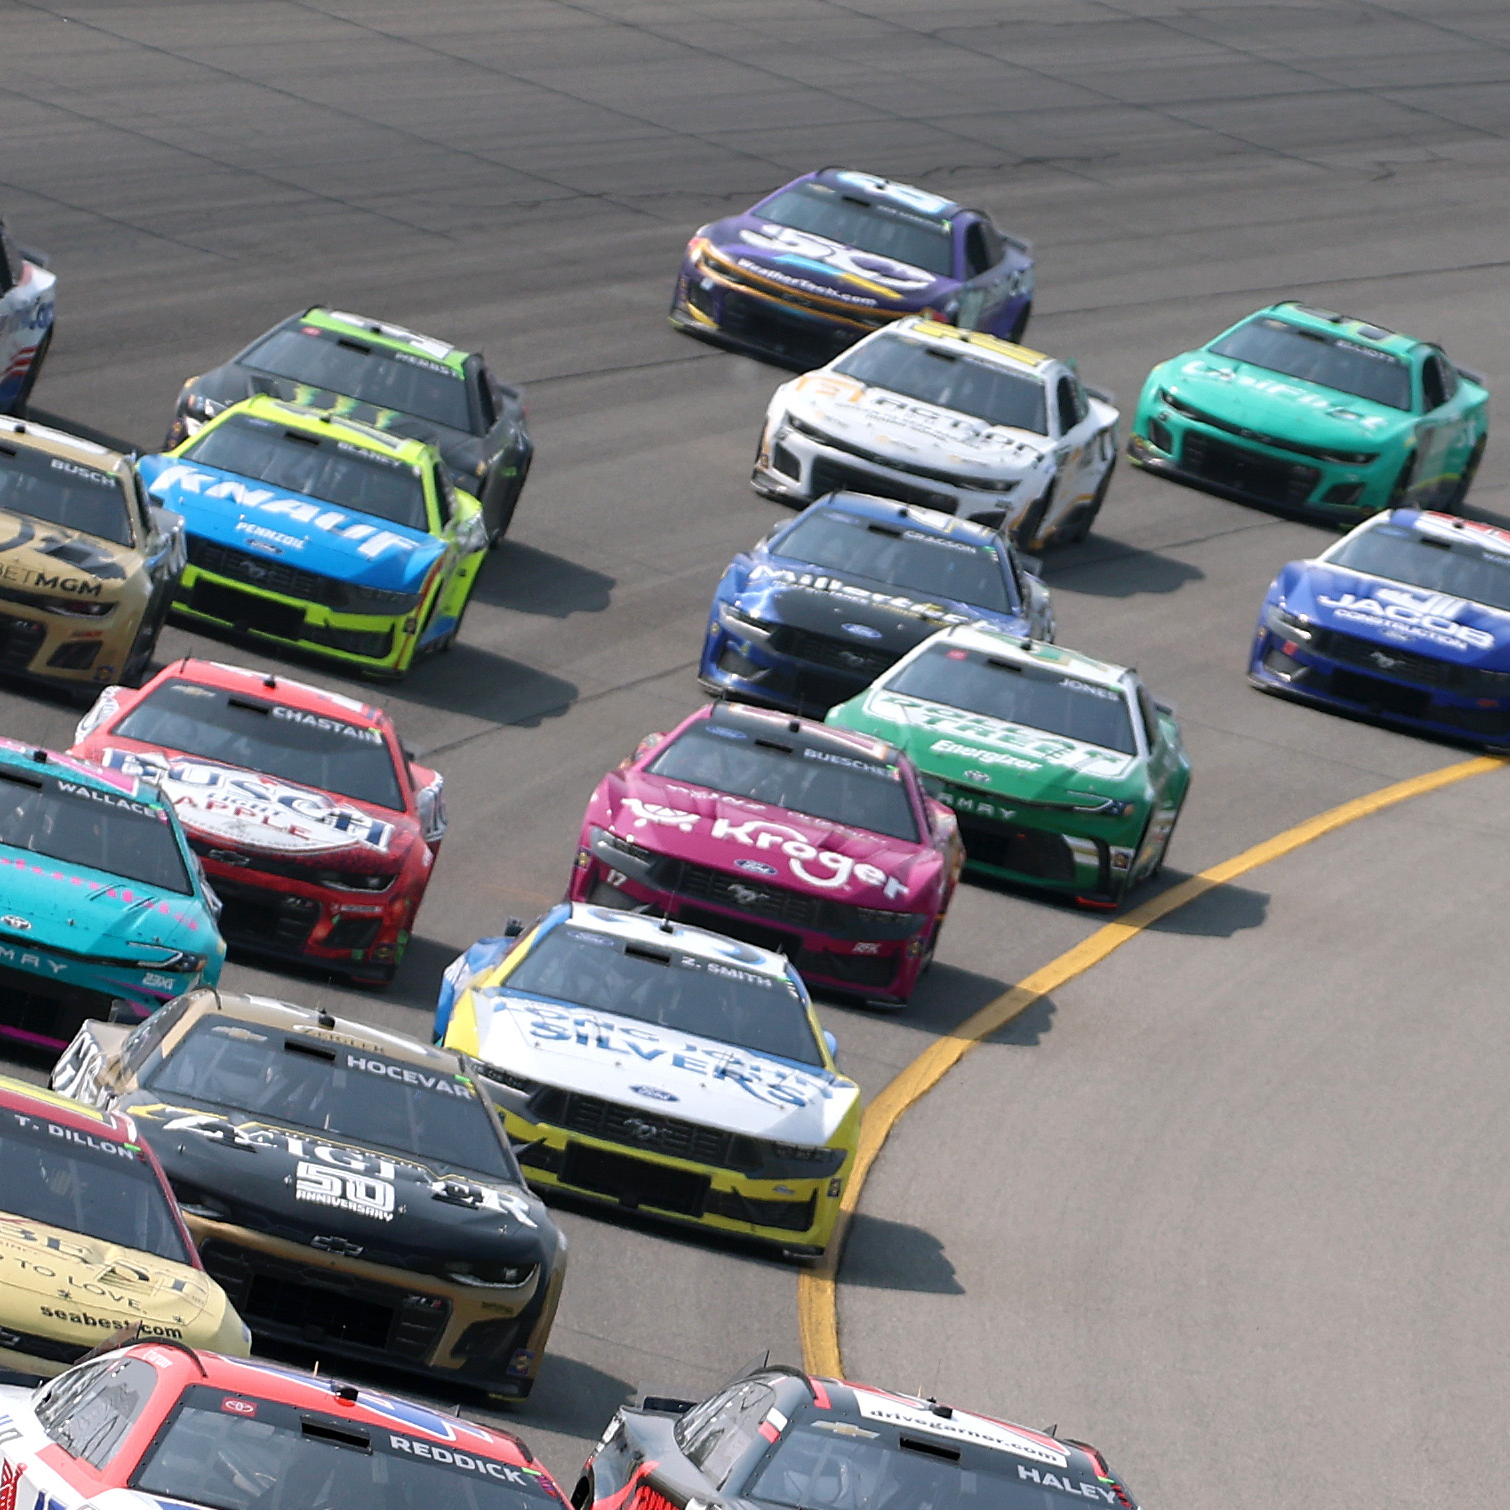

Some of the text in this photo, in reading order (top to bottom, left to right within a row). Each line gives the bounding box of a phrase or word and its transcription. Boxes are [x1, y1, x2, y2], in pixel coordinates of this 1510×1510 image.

[738, 258, 878, 306] WeatherTech.com
[50, 459, 117, 487] BUSCH
[149, 465, 420, 562] KNAUF
[1317, 593, 1496, 650] JACOB
[1333, 608, 1468, 650] CONSTRUCTION
[1059, 678, 1121, 702] JONES
[273, 706, 382, 745] CHASTAIN
[930, 740, 1043, 771] Energizer
[57, 780, 157, 820] WALLACE
[173, 796, 313, 841] APPLE
[939, 793, 1017, 819] AMRY
[606, 868, 628, 887] 17
[711, 818, 910, 899] Kroger
[707, 962, 773, 988] SMITH
[347, 1053, 473, 1099] HOCEVAR
[14, 1113, 136, 1160] T. DILLON
[295, 1190, 394, 1223] ANNIVERSARY
[13, 1256, 56, 1278] TO
[68, 1275, 150, 1314] LOVE.
[41, 1303, 184, 1340] seabestcom
[869, 1407, 1058, 1464] drivegarner.com
[388, 1432, 528, 1487] REDDICK
[1017, 1463, 1118, 1506] HALEY
